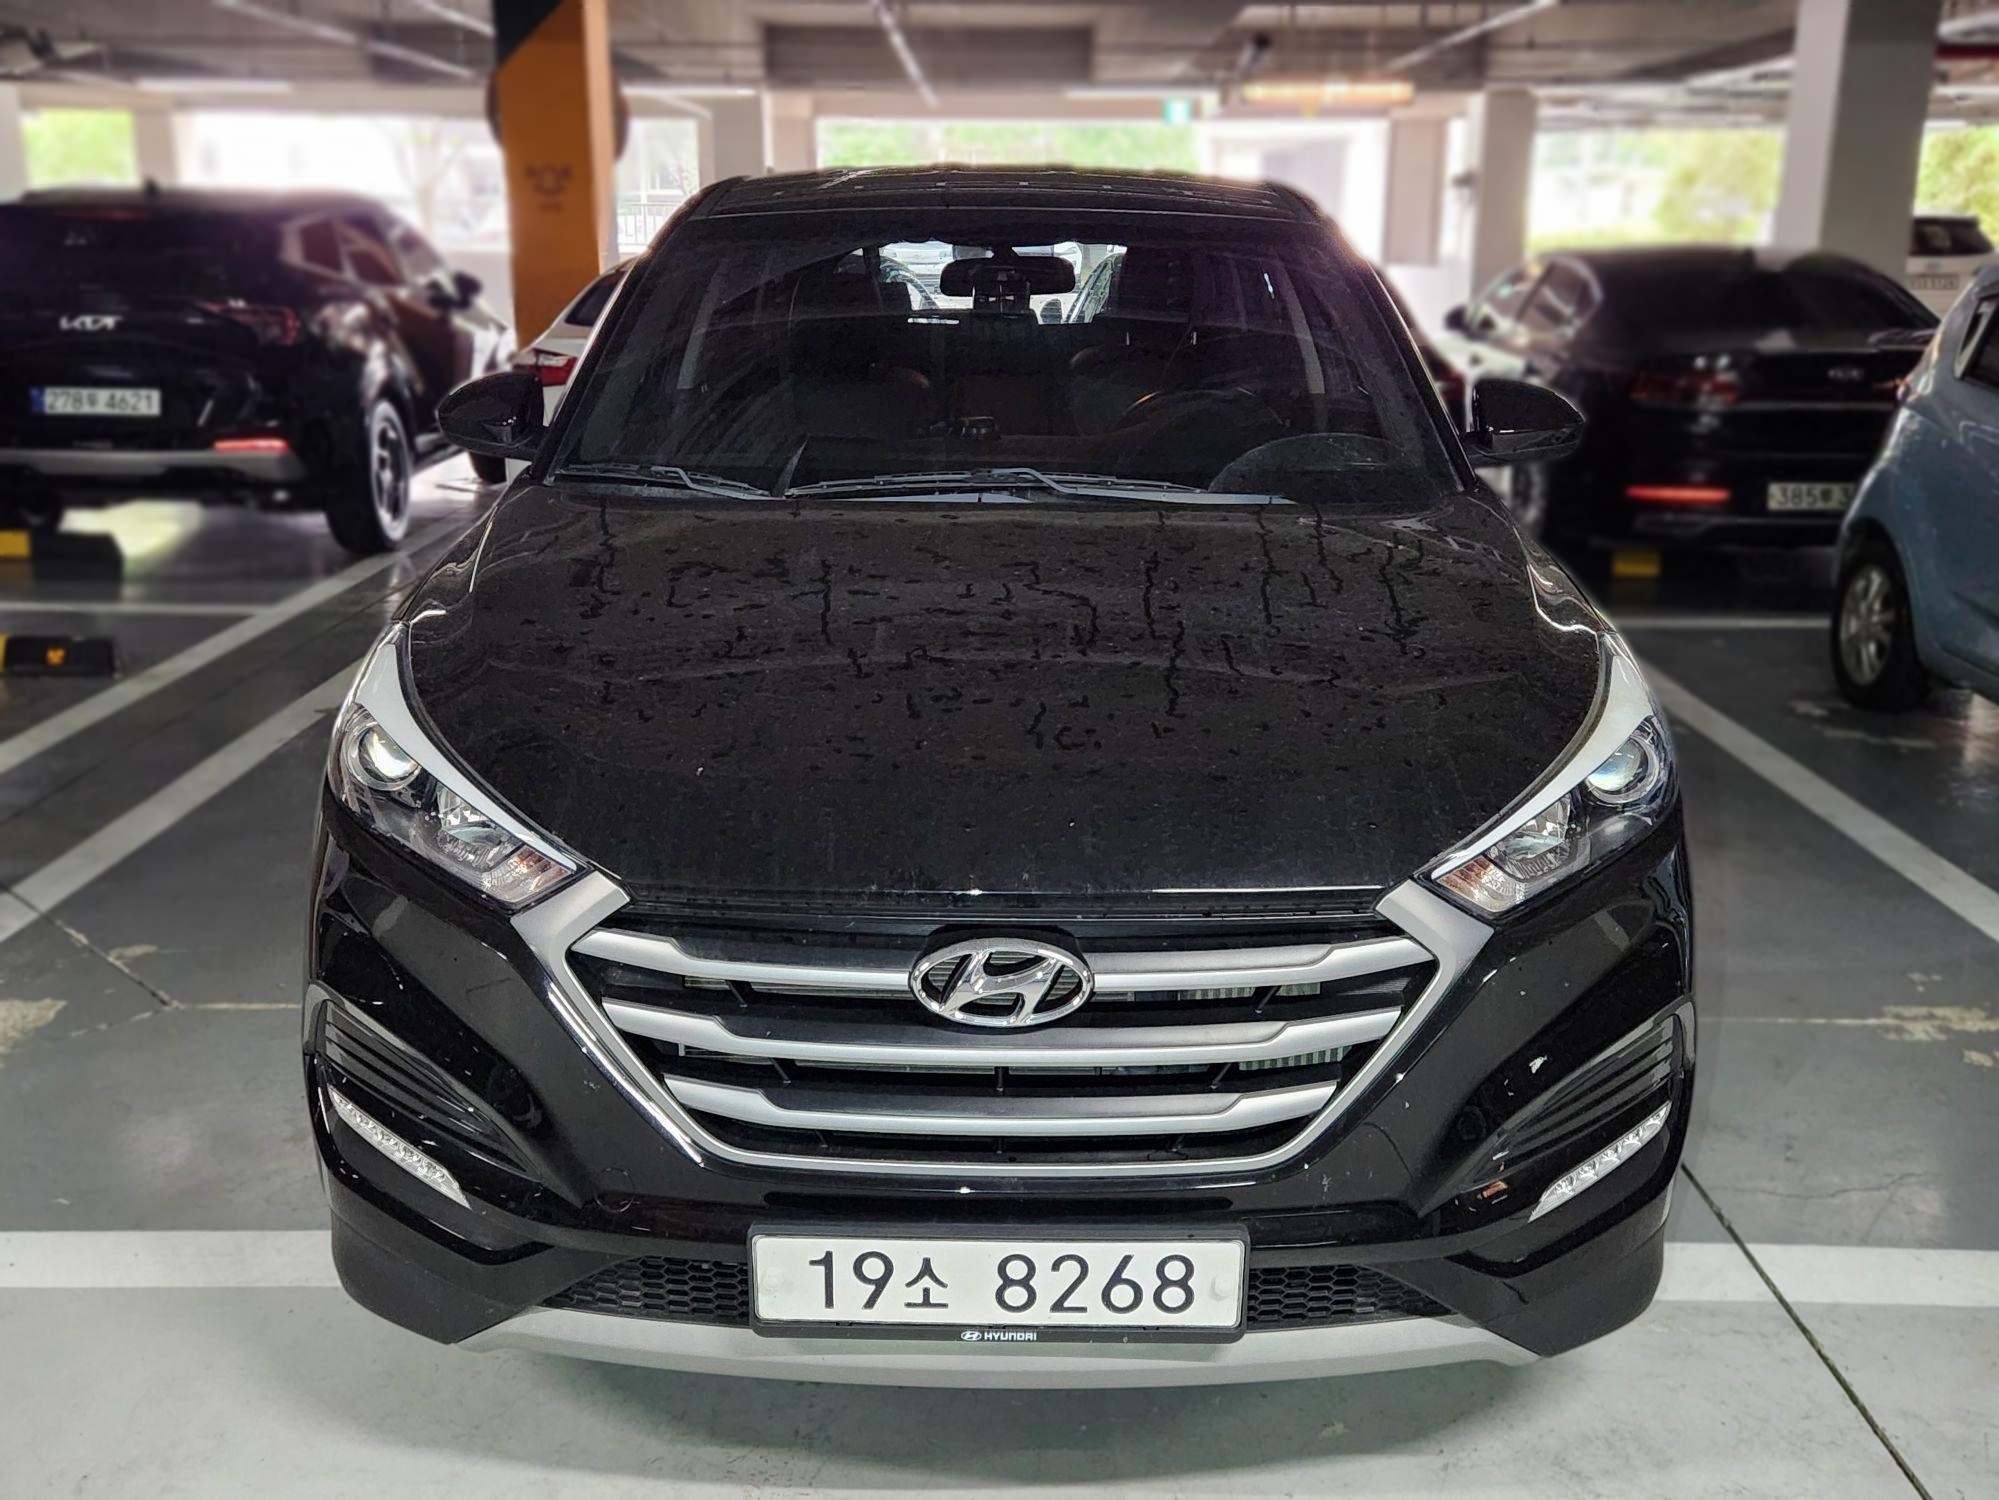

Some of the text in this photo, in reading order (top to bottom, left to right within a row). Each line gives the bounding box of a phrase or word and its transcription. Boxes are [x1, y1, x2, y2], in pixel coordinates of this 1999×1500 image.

[808, 1250, 1195, 1315] 19소 8268
[983, 1331, 1037, 1341] HYUNDAI
